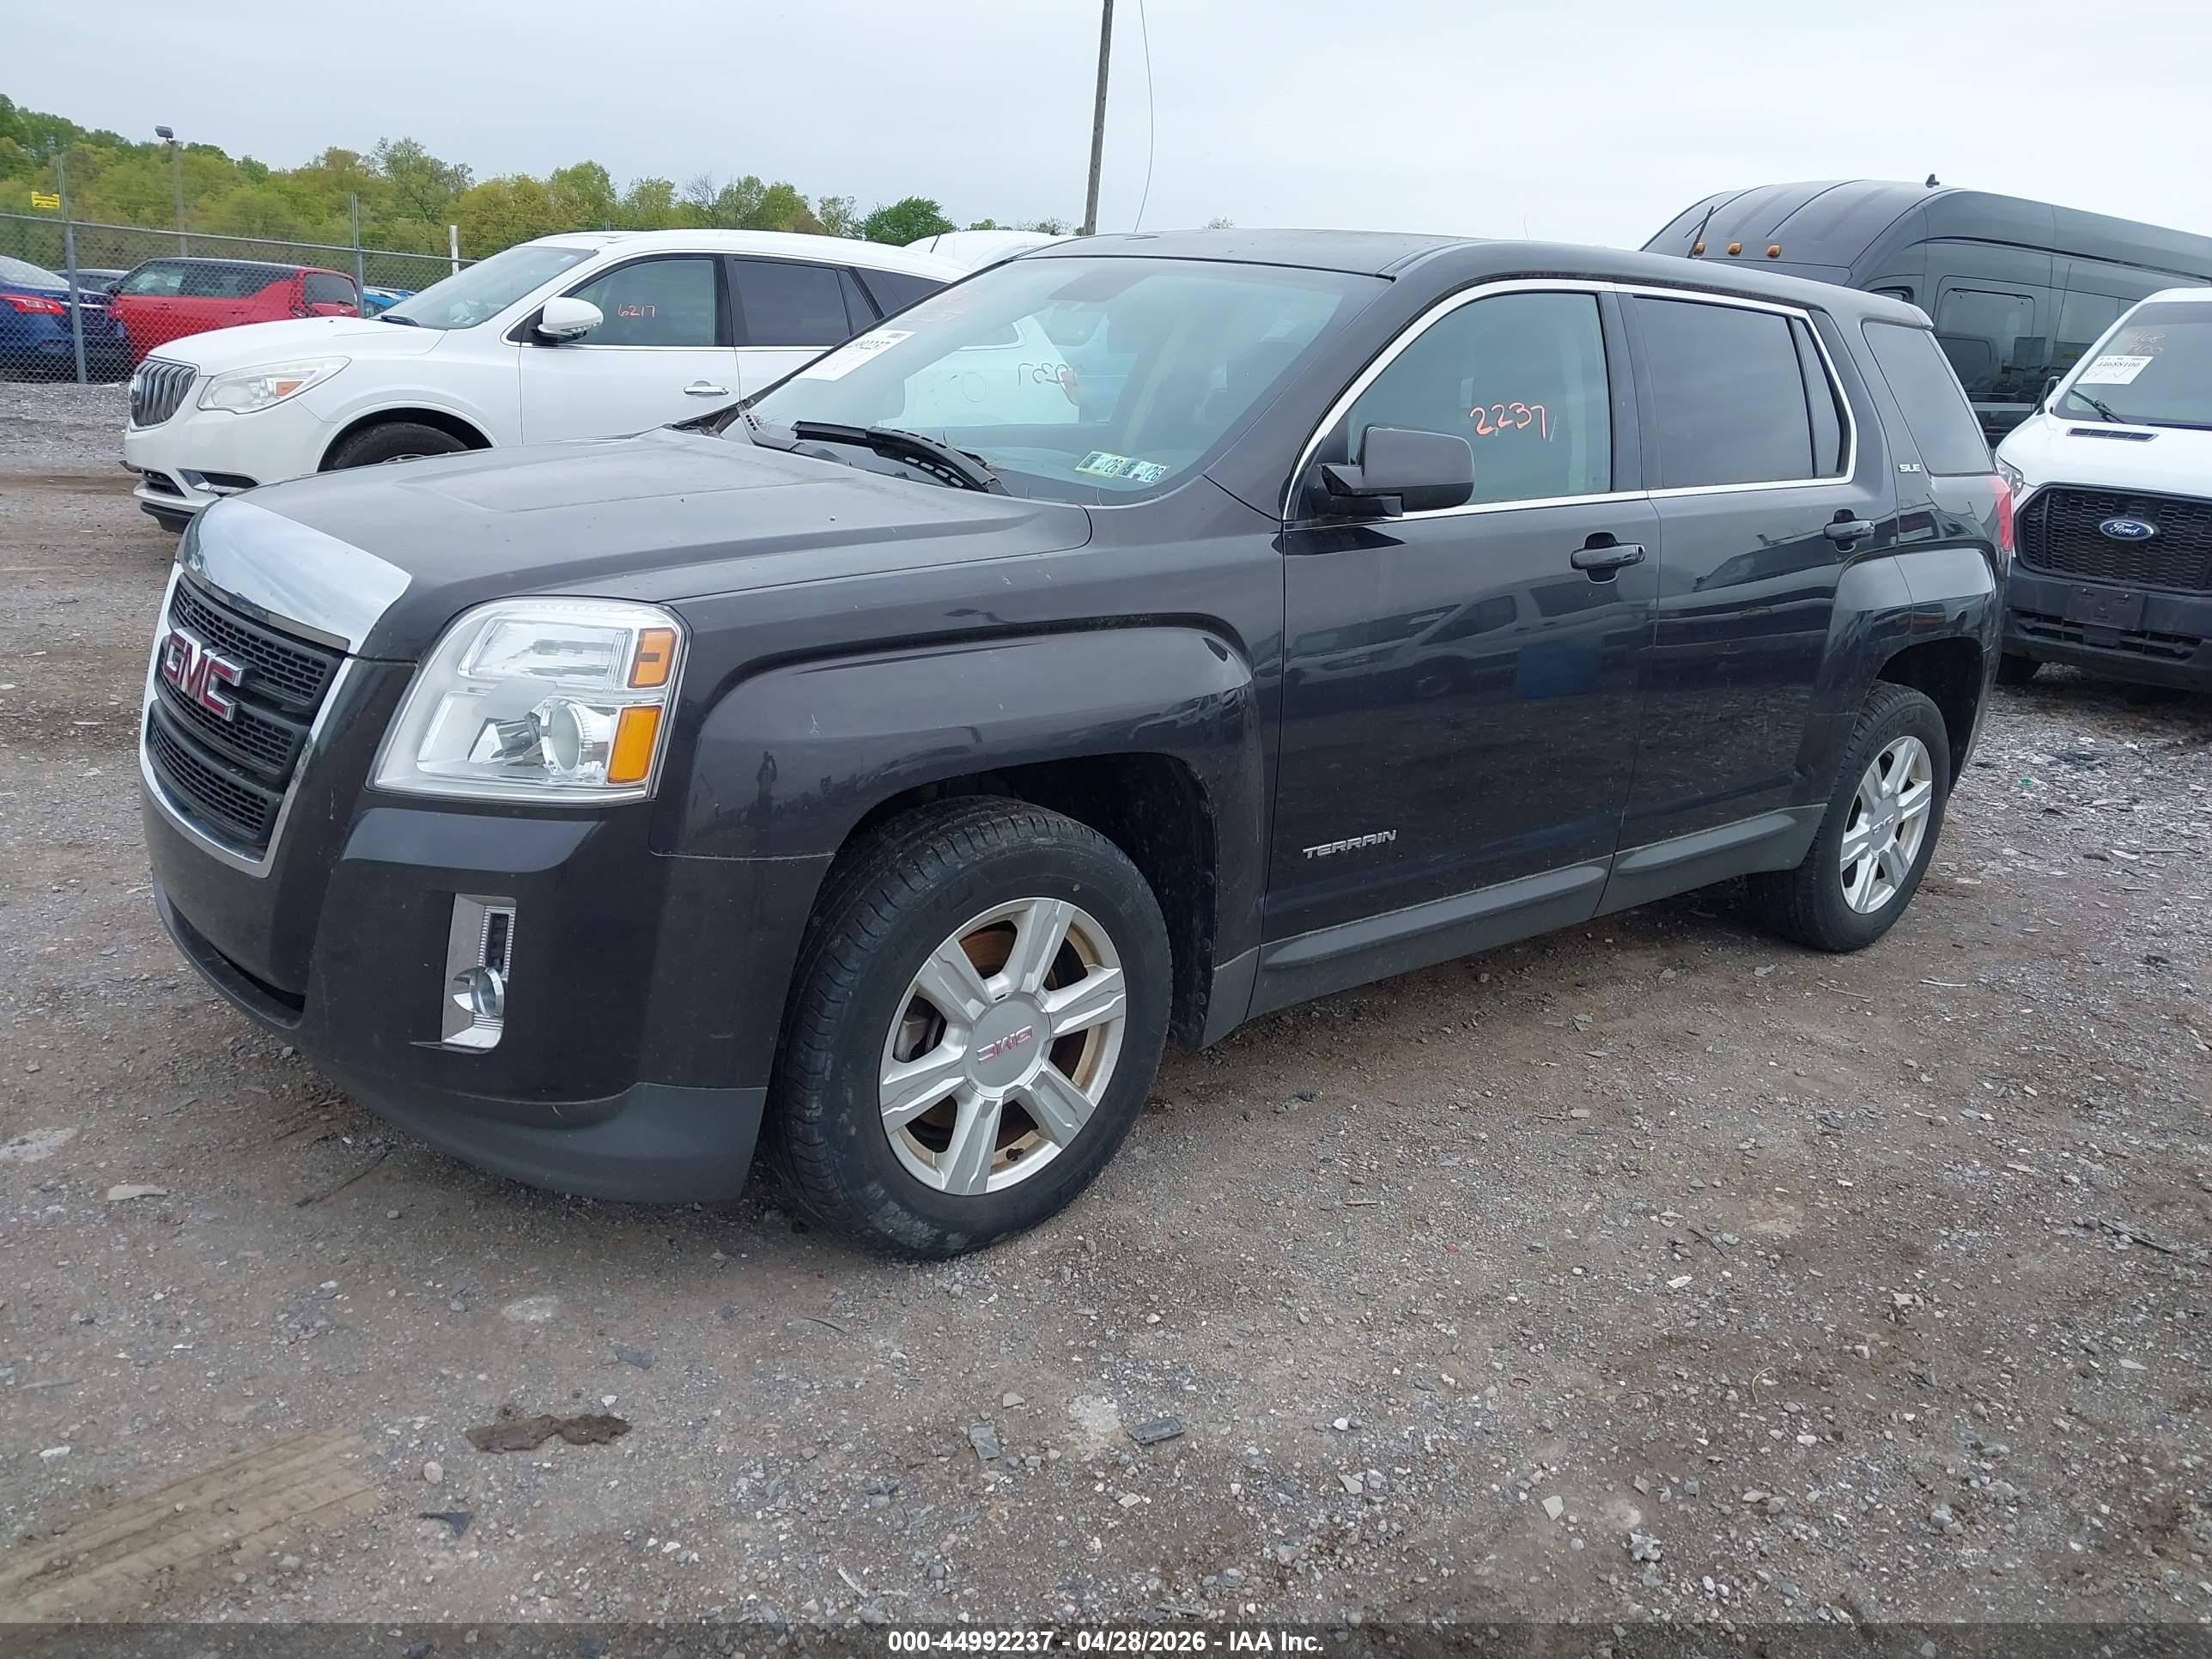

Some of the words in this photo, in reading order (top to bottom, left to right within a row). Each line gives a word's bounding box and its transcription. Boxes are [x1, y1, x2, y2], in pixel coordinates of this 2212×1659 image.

[617, 302, 655, 318] 6217
[1469, 402, 1547, 441] 2237
[1899, 464, 1921, 472] SLE
[161, 628, 244, 722] GMC
[1303, 830, 1397, 859] TERRAIN
